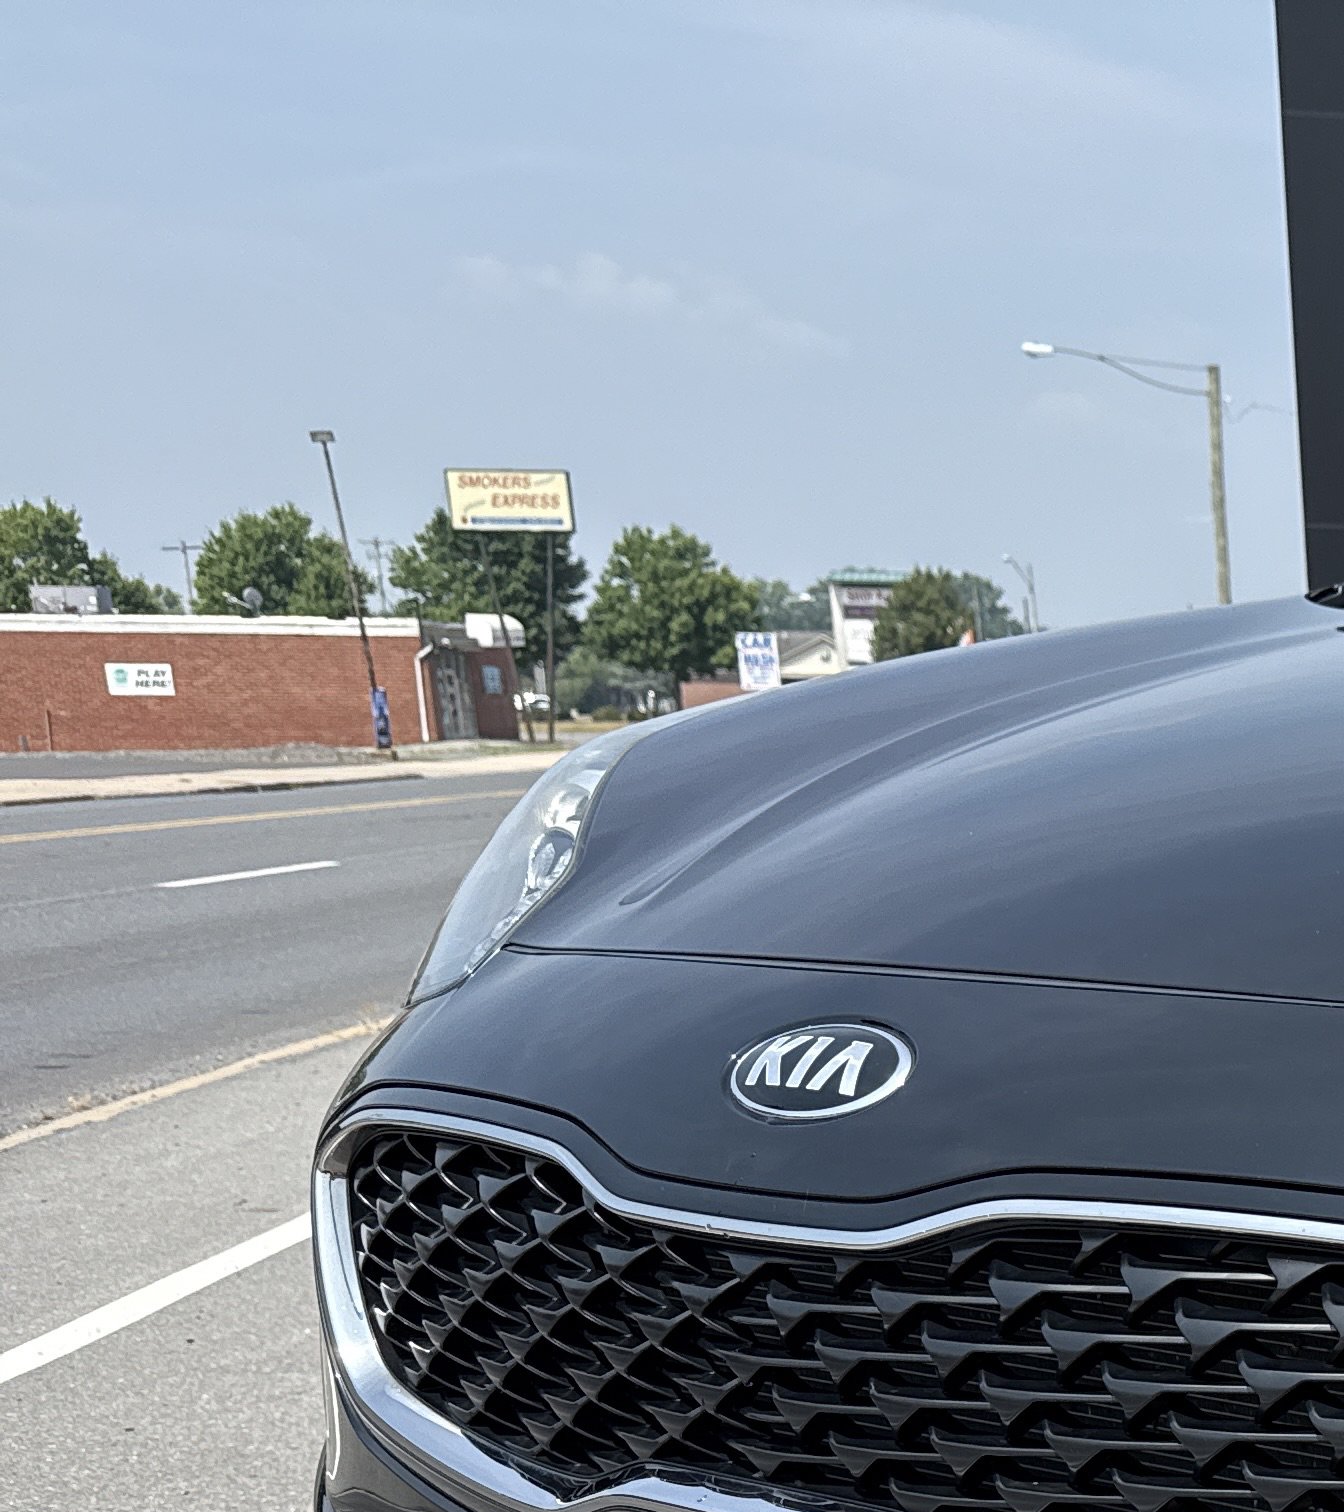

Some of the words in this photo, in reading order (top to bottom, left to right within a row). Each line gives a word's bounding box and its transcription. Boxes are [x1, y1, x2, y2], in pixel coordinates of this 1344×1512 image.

[458, 474, 532, 489] SMOKERS
[491, 493, 560, 509] EXPRESS
[136, 669, 167, 678] PLAY
[744, 1035, 874, 1097] KIA
